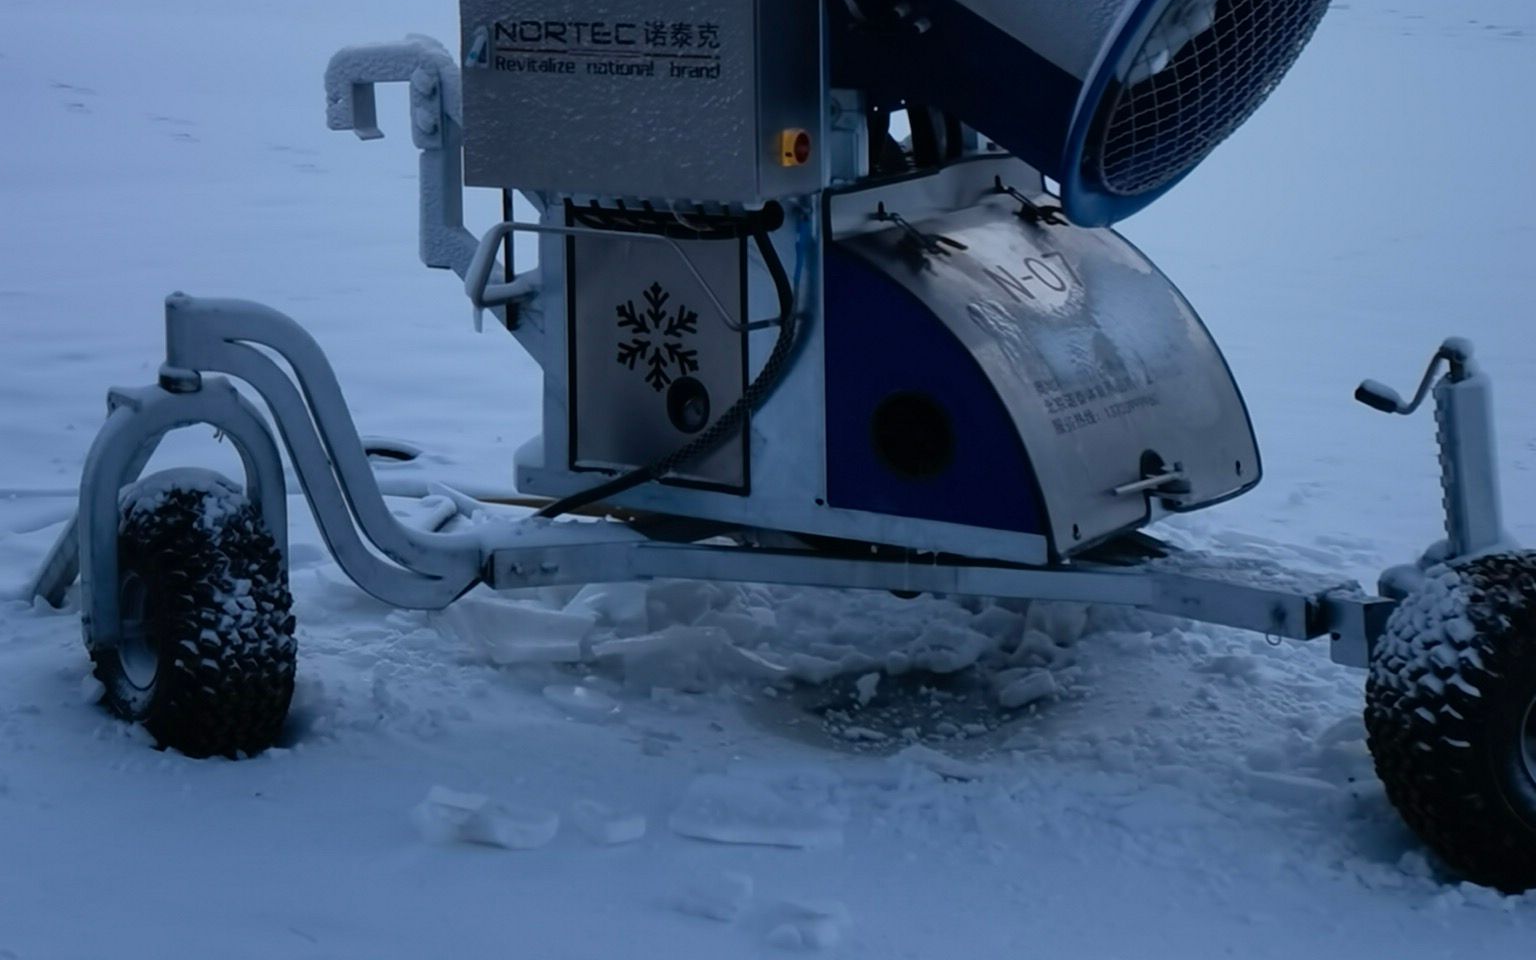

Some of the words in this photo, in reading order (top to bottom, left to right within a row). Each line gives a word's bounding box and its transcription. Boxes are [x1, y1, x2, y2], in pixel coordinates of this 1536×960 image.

[494, 20, 636, 45] NORTEC
[644, 21, 721, 49] 诺泰克
[495, 55, 576, 74] Revitalize
[587, 60, 654, 77] national
[669, 61, 721, 80] brand
[982, 250, 1085, 303] N-07
